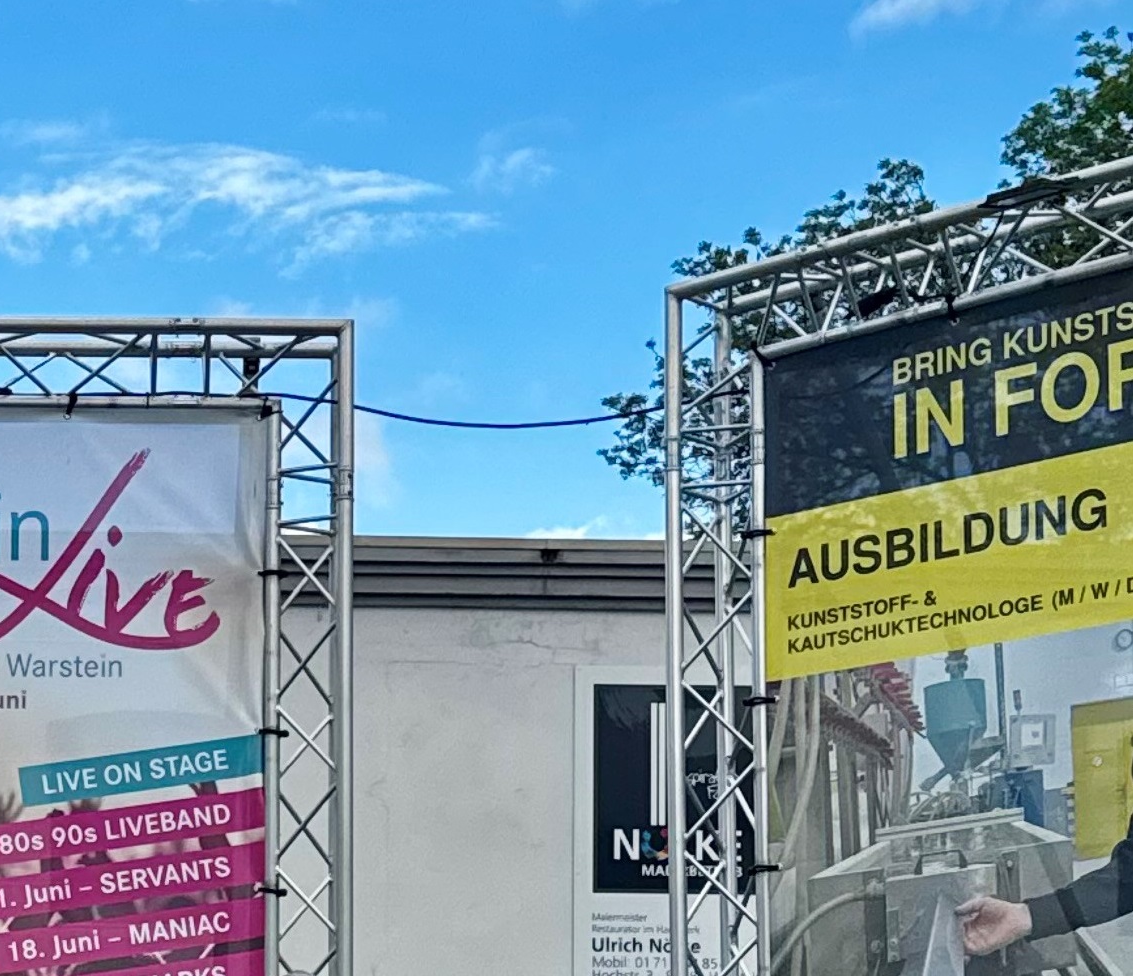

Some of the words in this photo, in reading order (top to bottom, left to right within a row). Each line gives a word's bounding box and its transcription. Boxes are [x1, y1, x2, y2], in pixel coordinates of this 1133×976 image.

[893, 337, 992, 387] BRING
[1003, 301, 1133, 360] KUNSTS
[893, 378, 964, 460] IN
[787, 488, 1108, 590] AUSBILDUNG
[787, 593, 919, 632] KUNSTSTOFF-
[924, 589, 937, 606] &
[787, 594, 1043, 654] KAUTSCHUKTECHNOLOGE
[7, 653, 123, 678] Warstein
[41, 767, 97, 796] LIVE
[103, 761, 143, 785] ON
[149, 749, 230, 779] STAGE
[51, 825, 98, 847] 90s
[104, 803, 232, 841] LIVEBAND
[23, 878, 72, 909] Juni
[99, 857, 232, 896] SERVANTS
[7, 939, 46, 963] 18.
[52, 929, 101, 961] Juni
[128, 911, 232, 946] MANIAC
[591, 936, 643, 953] Ulrich
